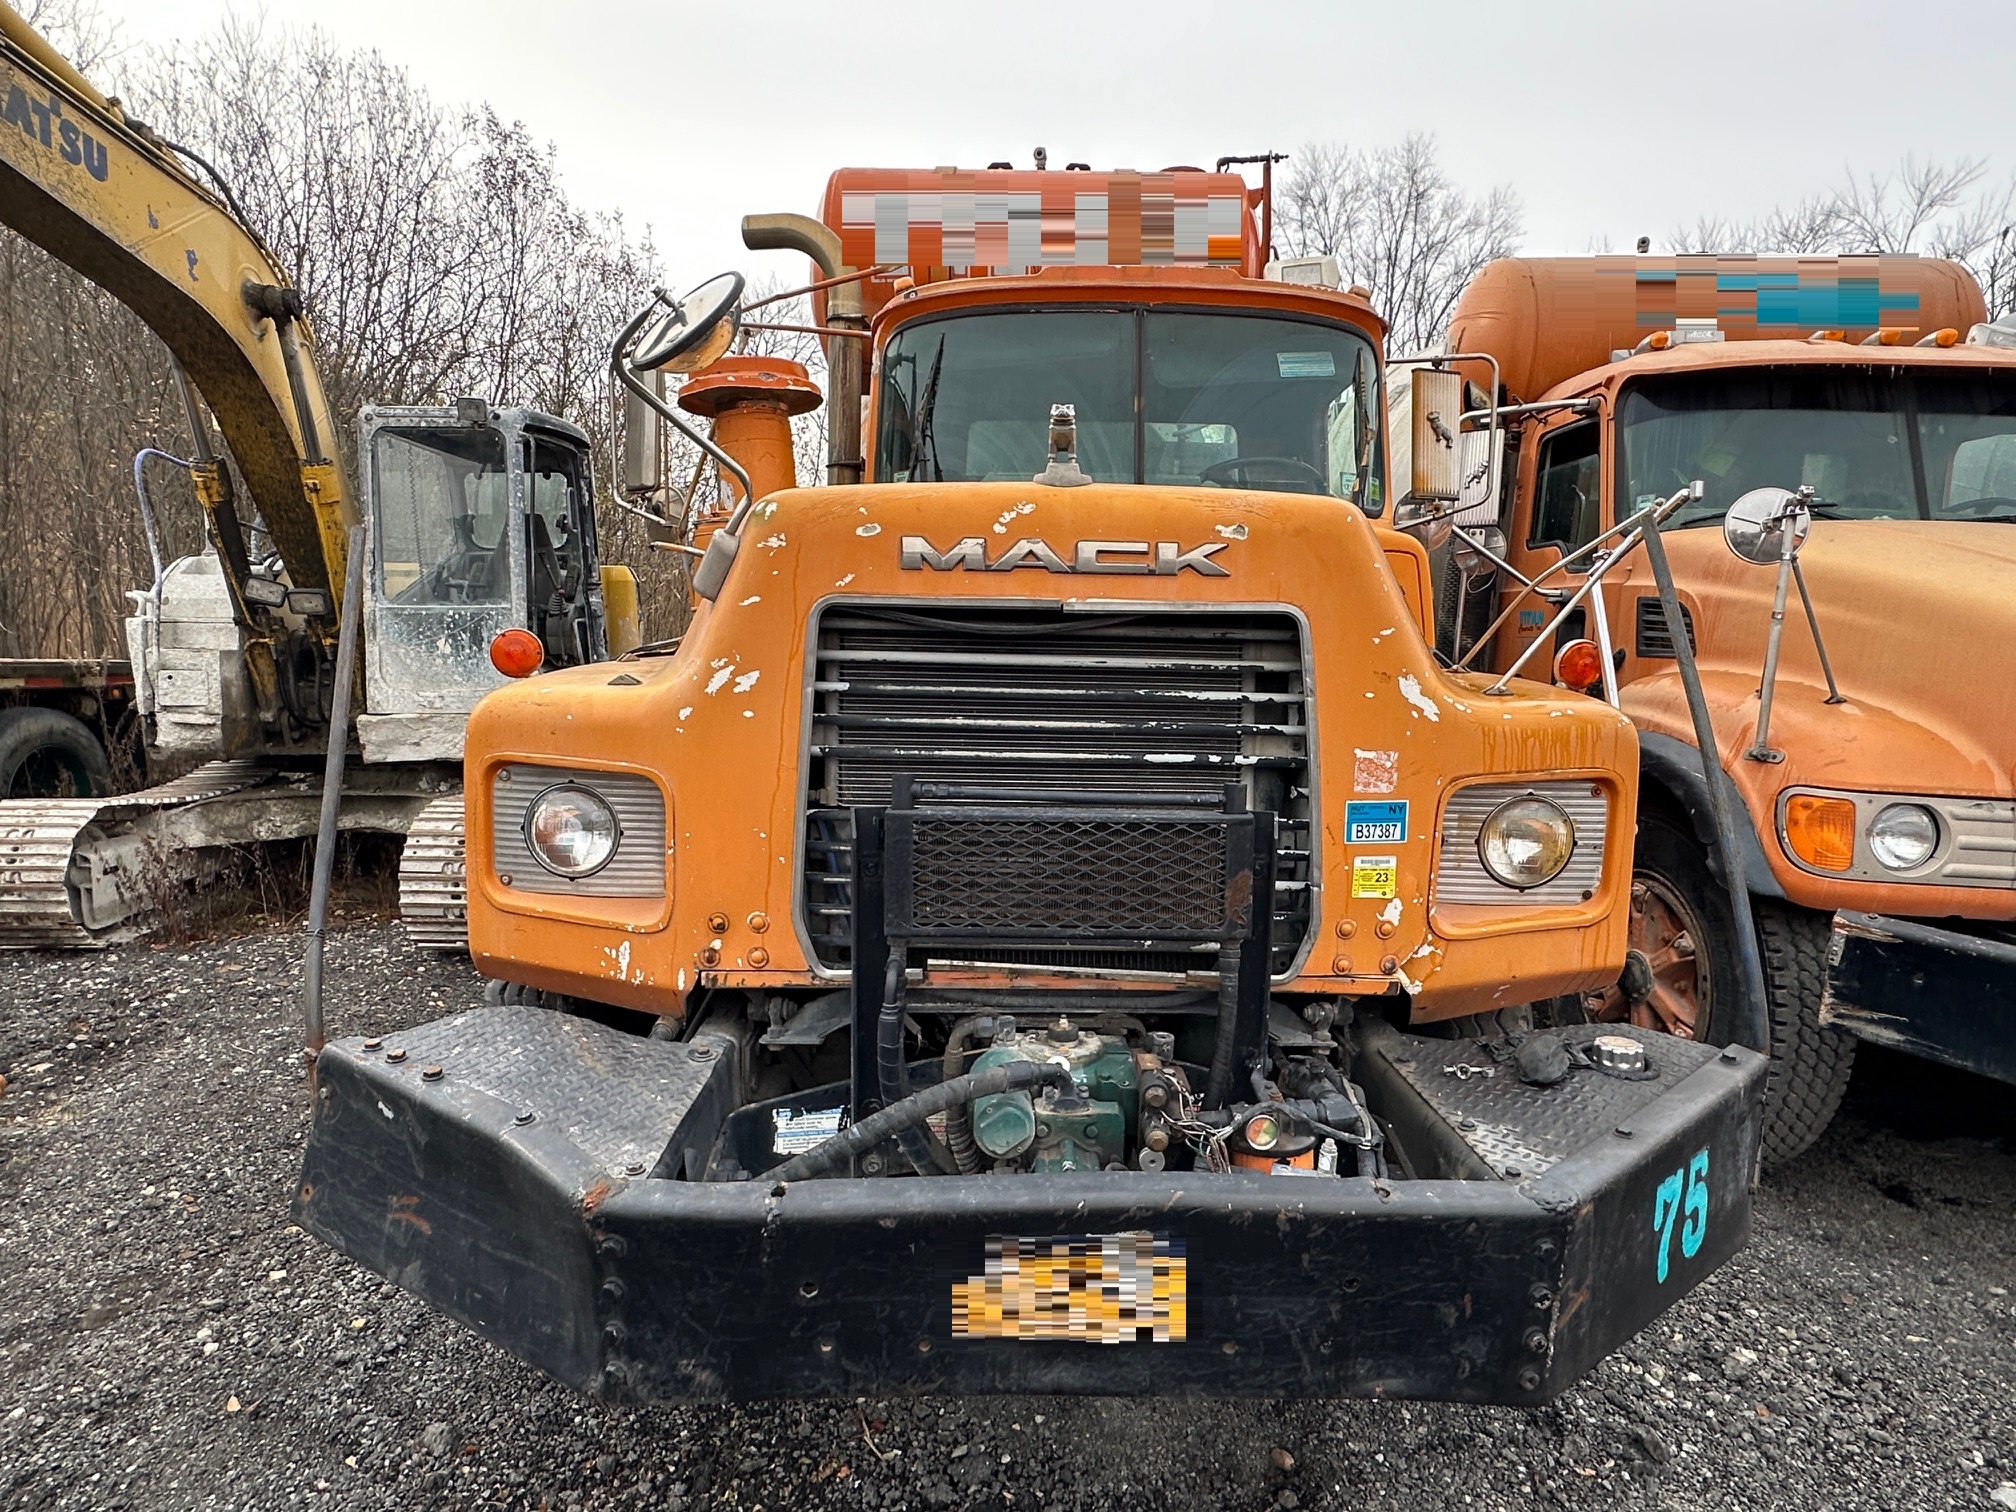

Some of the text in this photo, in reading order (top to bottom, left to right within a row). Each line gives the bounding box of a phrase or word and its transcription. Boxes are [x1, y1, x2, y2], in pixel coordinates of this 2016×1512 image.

[0, 84, 108, 182] ATSU
[900, 536, 1231, 576] MACK
[1388, 804, 1405, 814] NY
[1356, 824, 1398, 839] B37387
[1375, 872, 1389, 883] 23
[1654, 1148, 1709, 1284] 75
